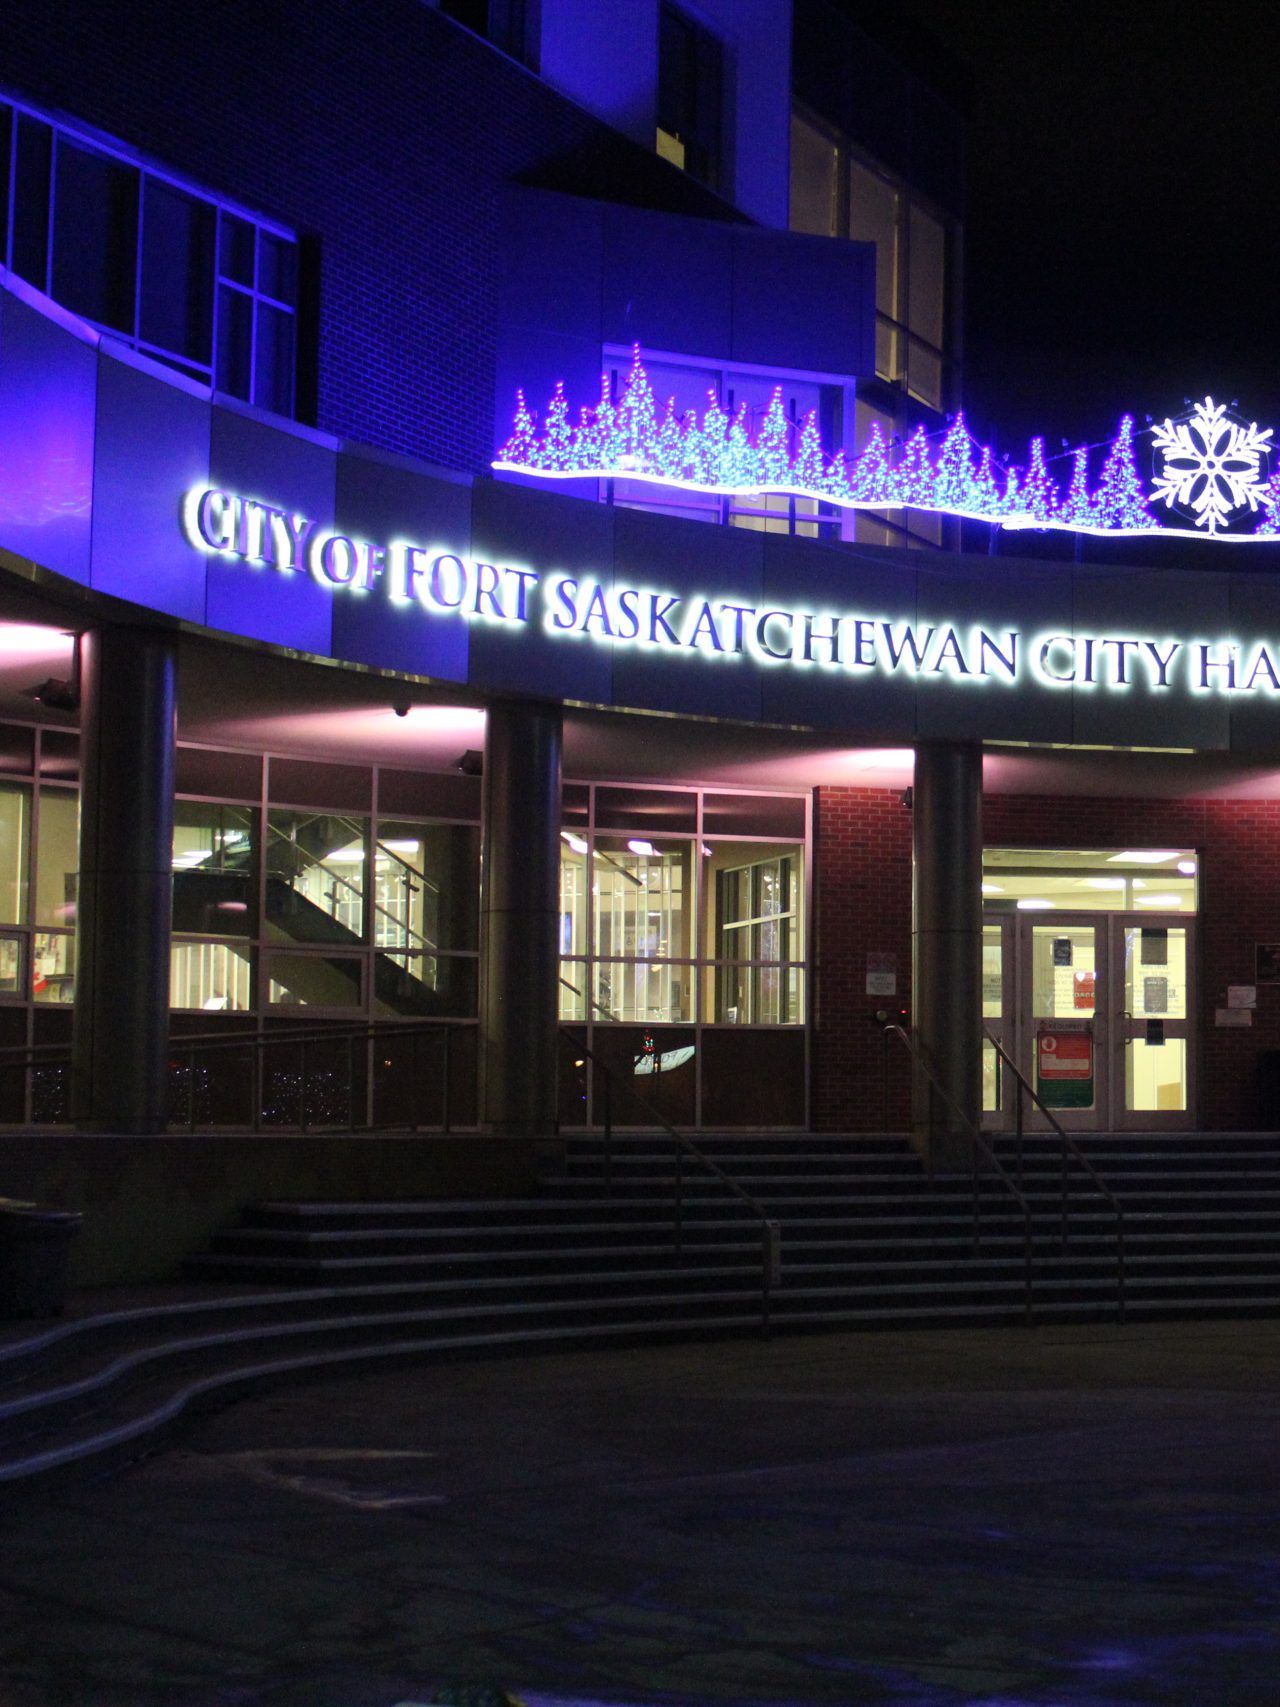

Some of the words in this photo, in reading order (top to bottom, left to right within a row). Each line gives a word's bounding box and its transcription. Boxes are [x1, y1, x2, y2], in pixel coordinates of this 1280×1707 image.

[195, 486, 317, 574] CITY
[320, 535, 386, 591] OF
[400, 543, 539, 622] FORT
[553, 578, 1020, 677] SASKATCHEWAN
[1038, 635, 1182, 687] CITY
